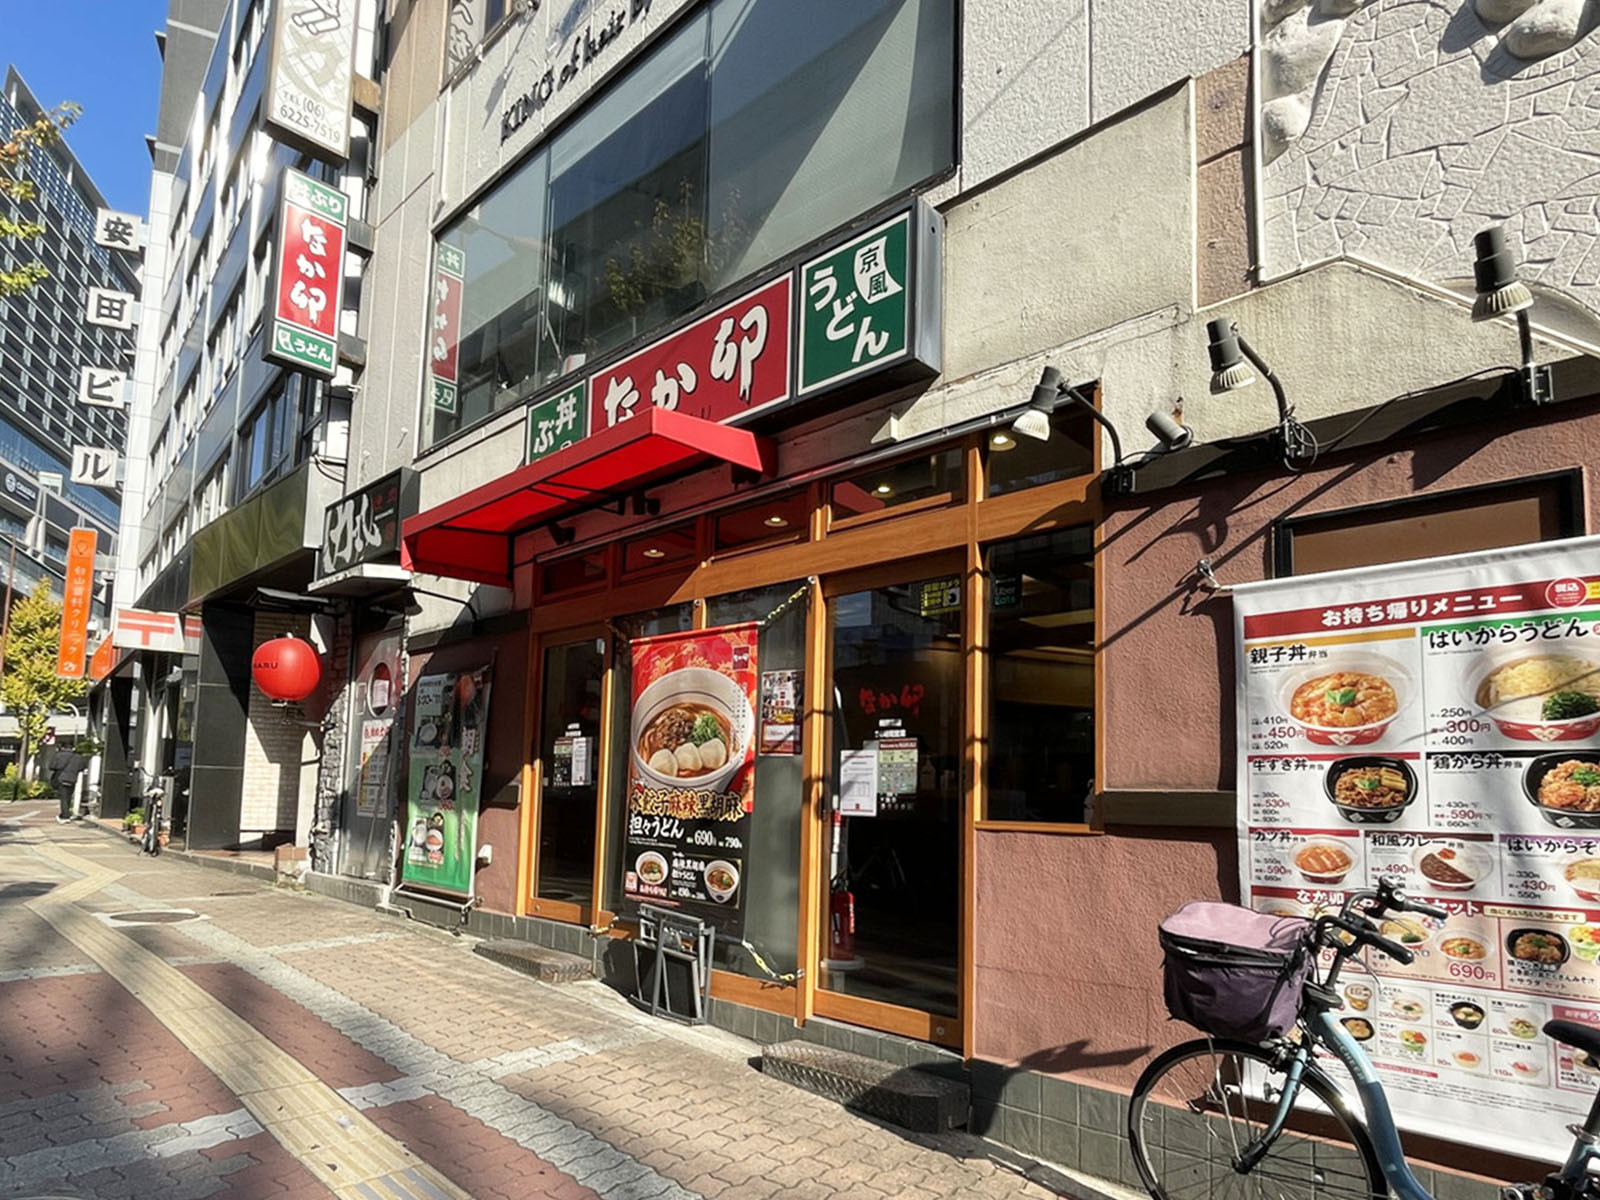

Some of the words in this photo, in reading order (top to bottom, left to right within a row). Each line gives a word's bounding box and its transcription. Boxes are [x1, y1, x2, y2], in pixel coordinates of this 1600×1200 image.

[279, 105, 341, 145] 6225-7519
[302, 94, 326, 121] (06)
[290, 218, 327, 324] なか卯
[859, 246, 888, 300] 京風
[809, 265, 890, 363] うどん
[604, 305, 768, 427] なか卯
[1321, 595, 1523, 626] お持ち帰りメニュー
[1430, 618, 1588, 649] はいからうどん
[629, 812, 684, 838] 担々うどん
[1450, 962, 1496, 982] 690円
